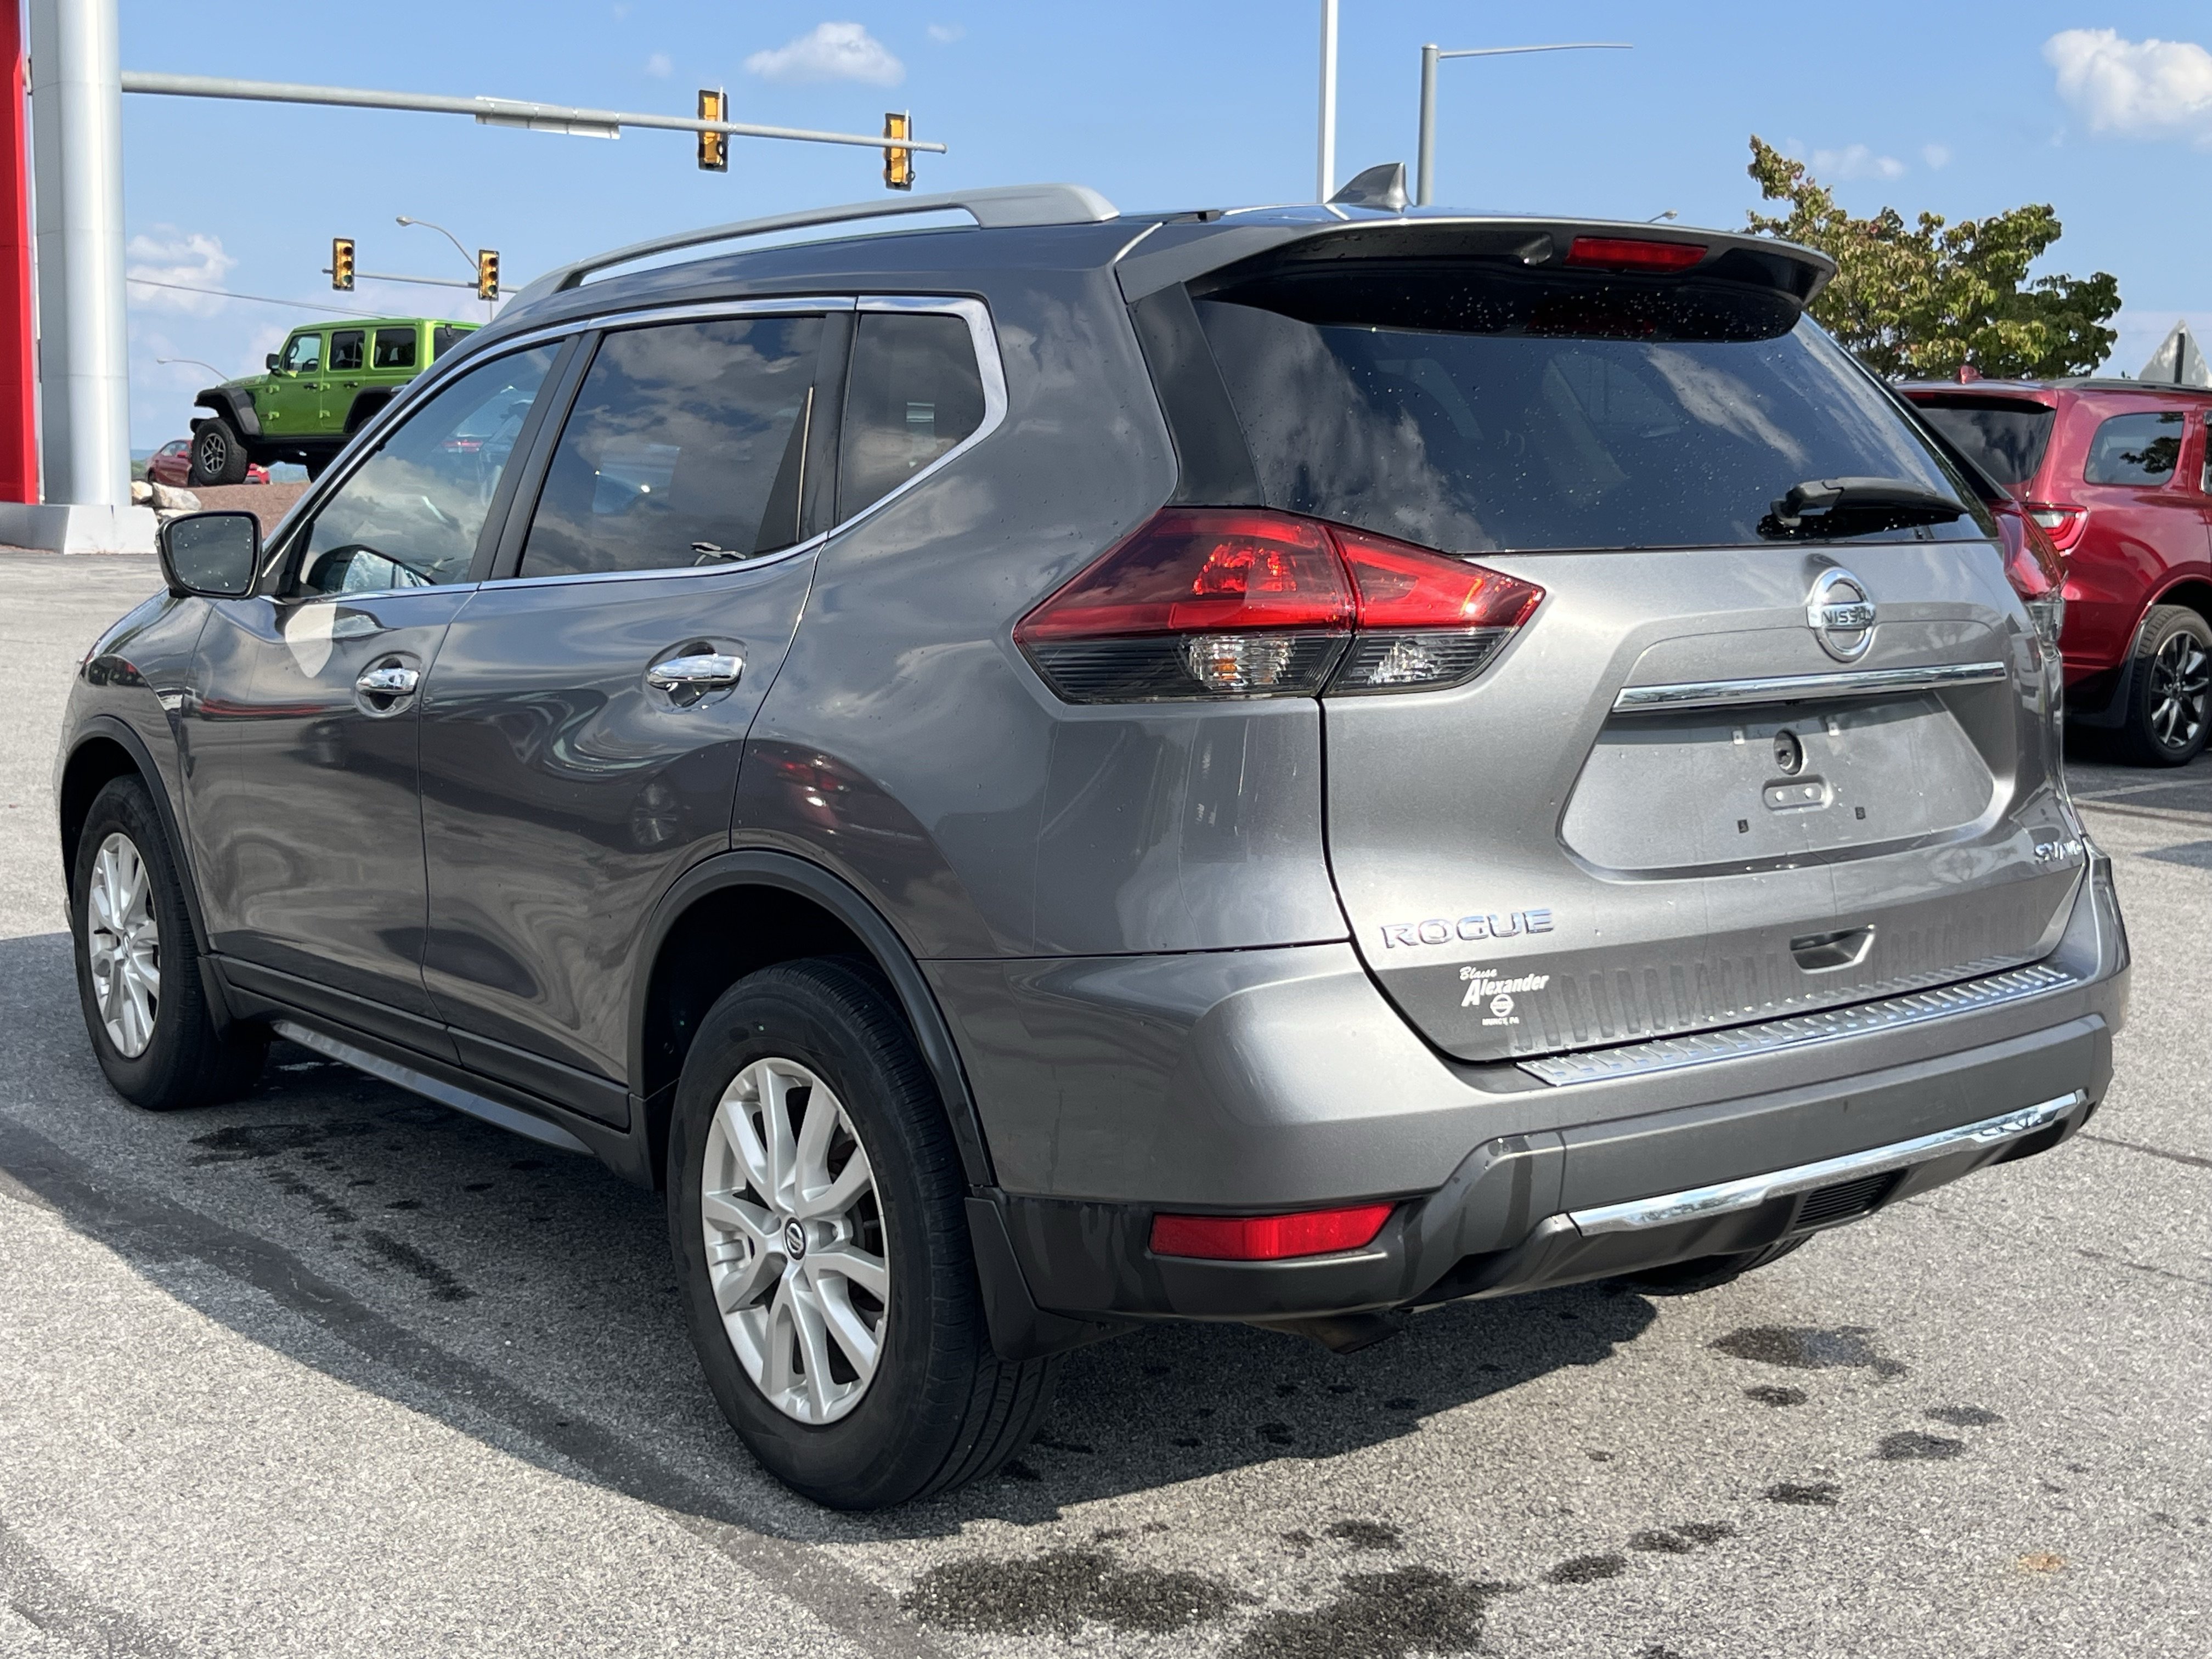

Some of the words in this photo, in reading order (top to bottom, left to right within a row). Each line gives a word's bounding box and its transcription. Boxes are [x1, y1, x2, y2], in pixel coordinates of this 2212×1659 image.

[1381, 909, 1554, 949] ROGUE
[1459, 966, 1497, 980] Blaise
[1461, 973, 1550, 1007] Alexander
